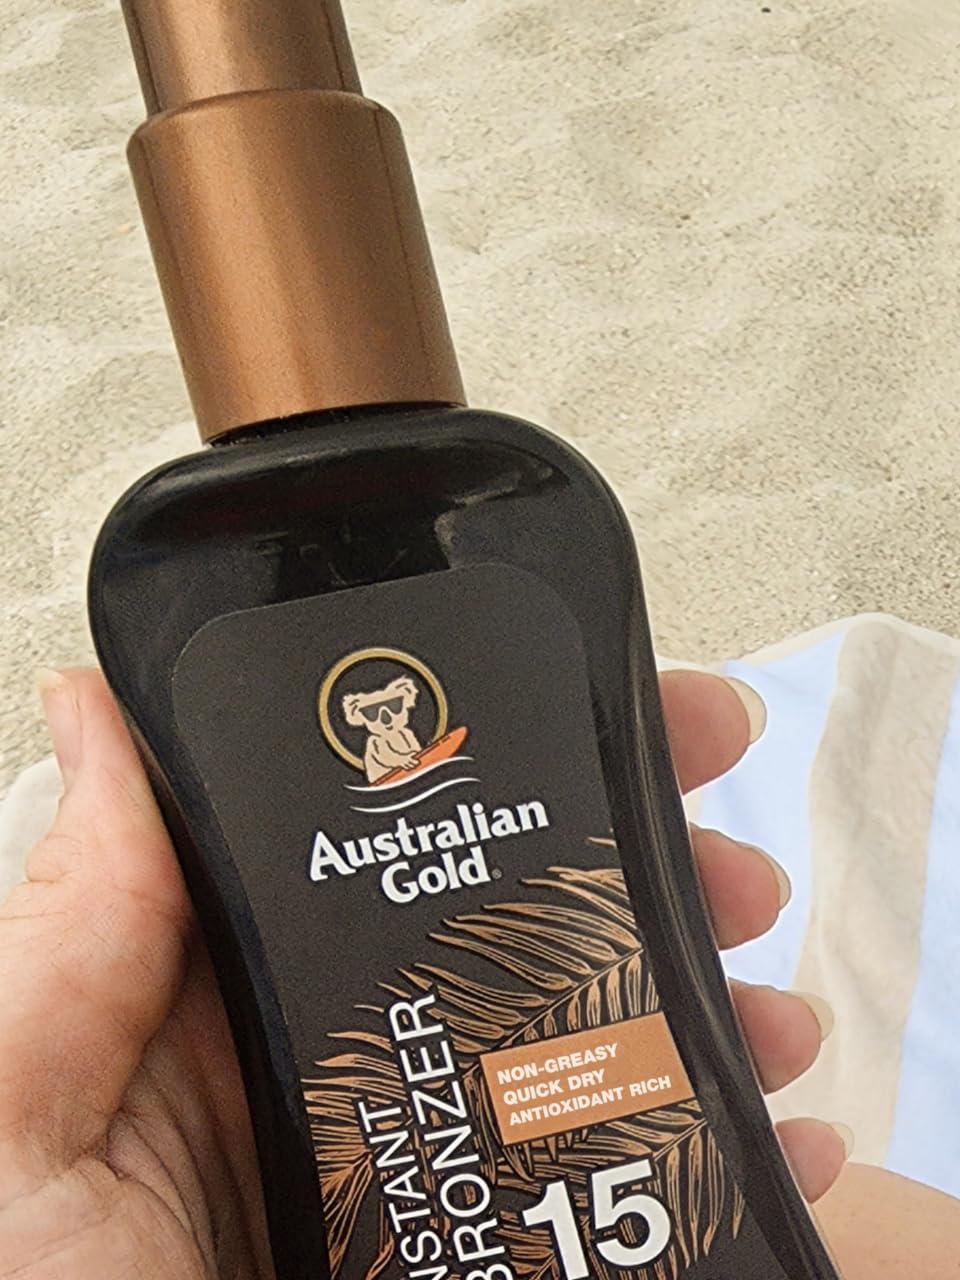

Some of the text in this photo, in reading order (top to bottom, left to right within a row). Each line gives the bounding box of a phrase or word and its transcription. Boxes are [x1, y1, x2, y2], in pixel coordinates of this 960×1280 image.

[310, 800, 549, 881] Australian
[497, 1043, 618, 1085] NON-GREASY
[503, 1068, 606, 1105] QUICK DRY
[509, 1075, 671, 1126] ANTIOXIDANT RICH
